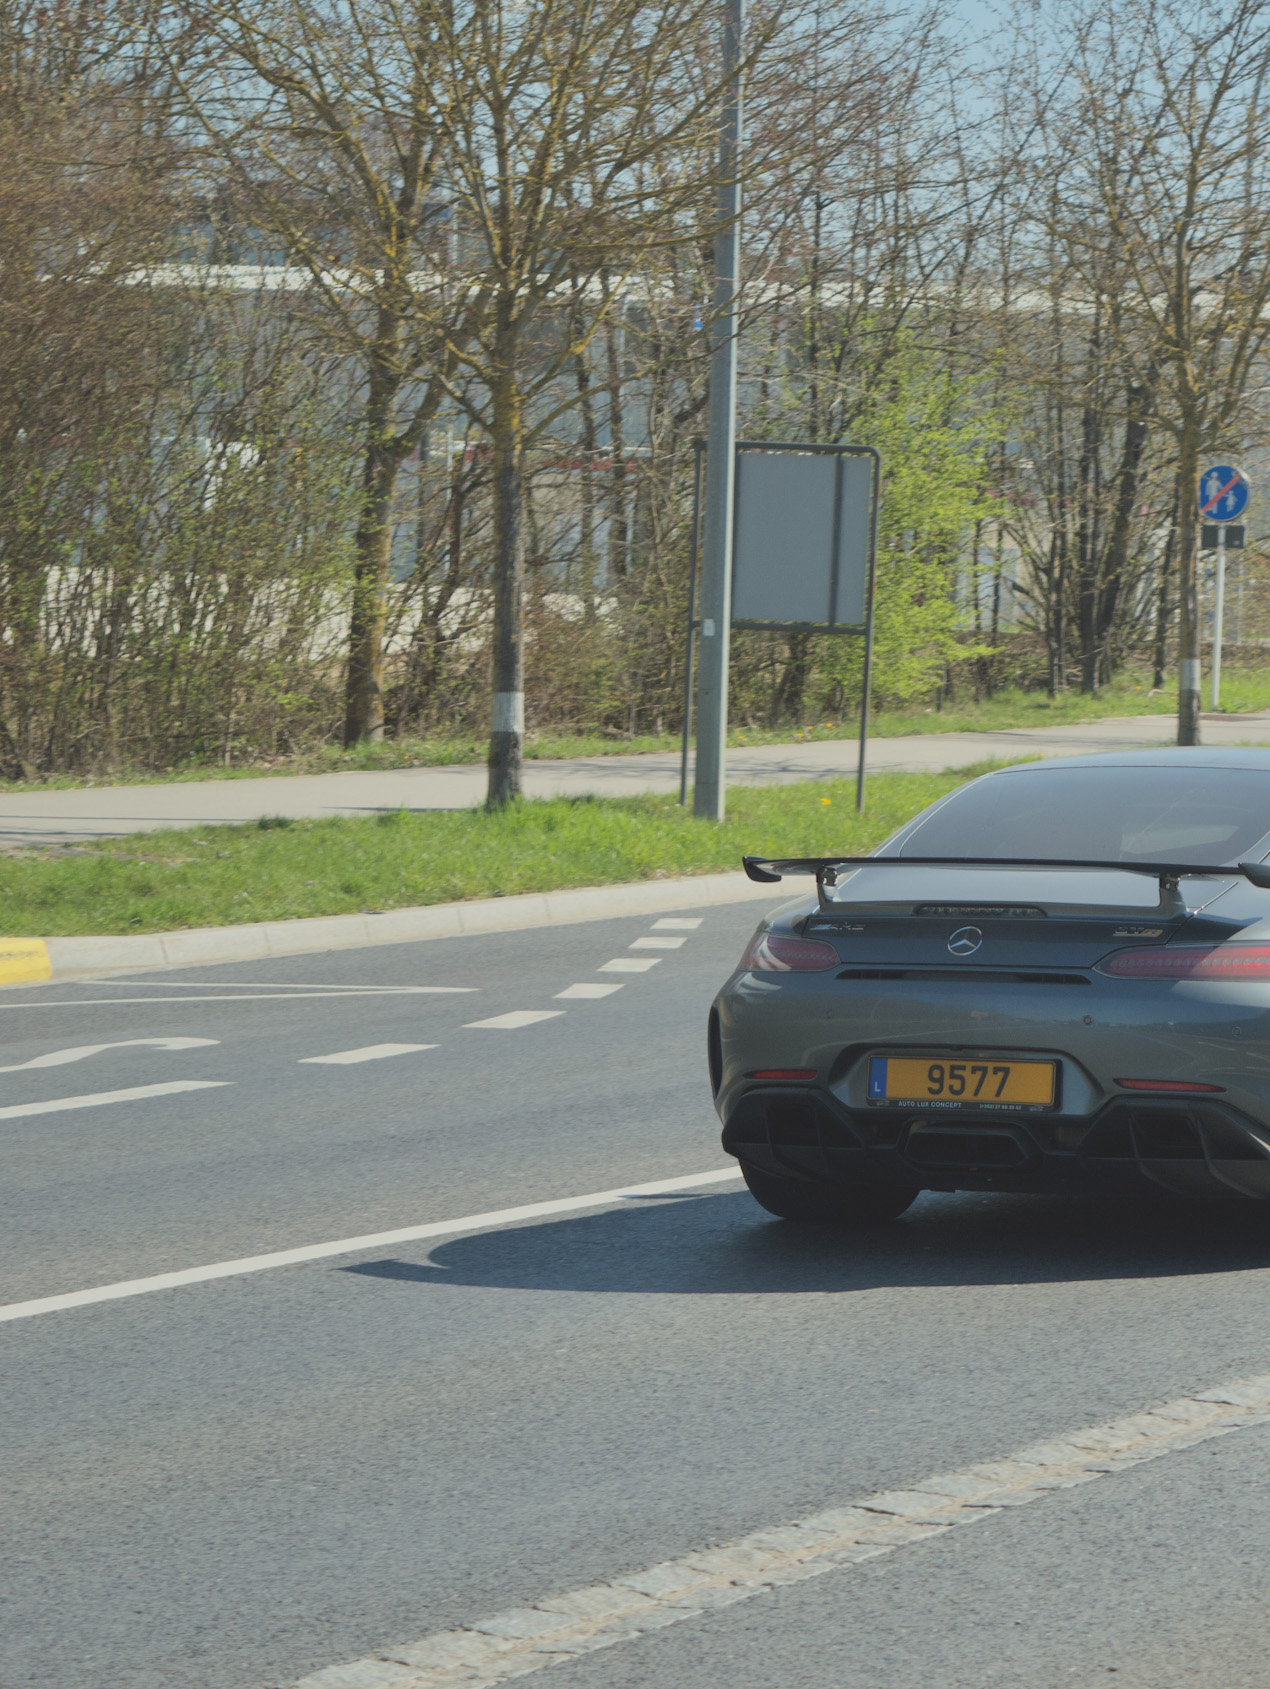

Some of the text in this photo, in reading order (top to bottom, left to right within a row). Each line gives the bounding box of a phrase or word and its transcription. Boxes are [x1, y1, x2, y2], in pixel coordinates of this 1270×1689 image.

[927, 1064, 1011, 1097] 9577
[874, 1081, 881, 1092] L
[930, 1101, 963, 1109] CONCEPT
